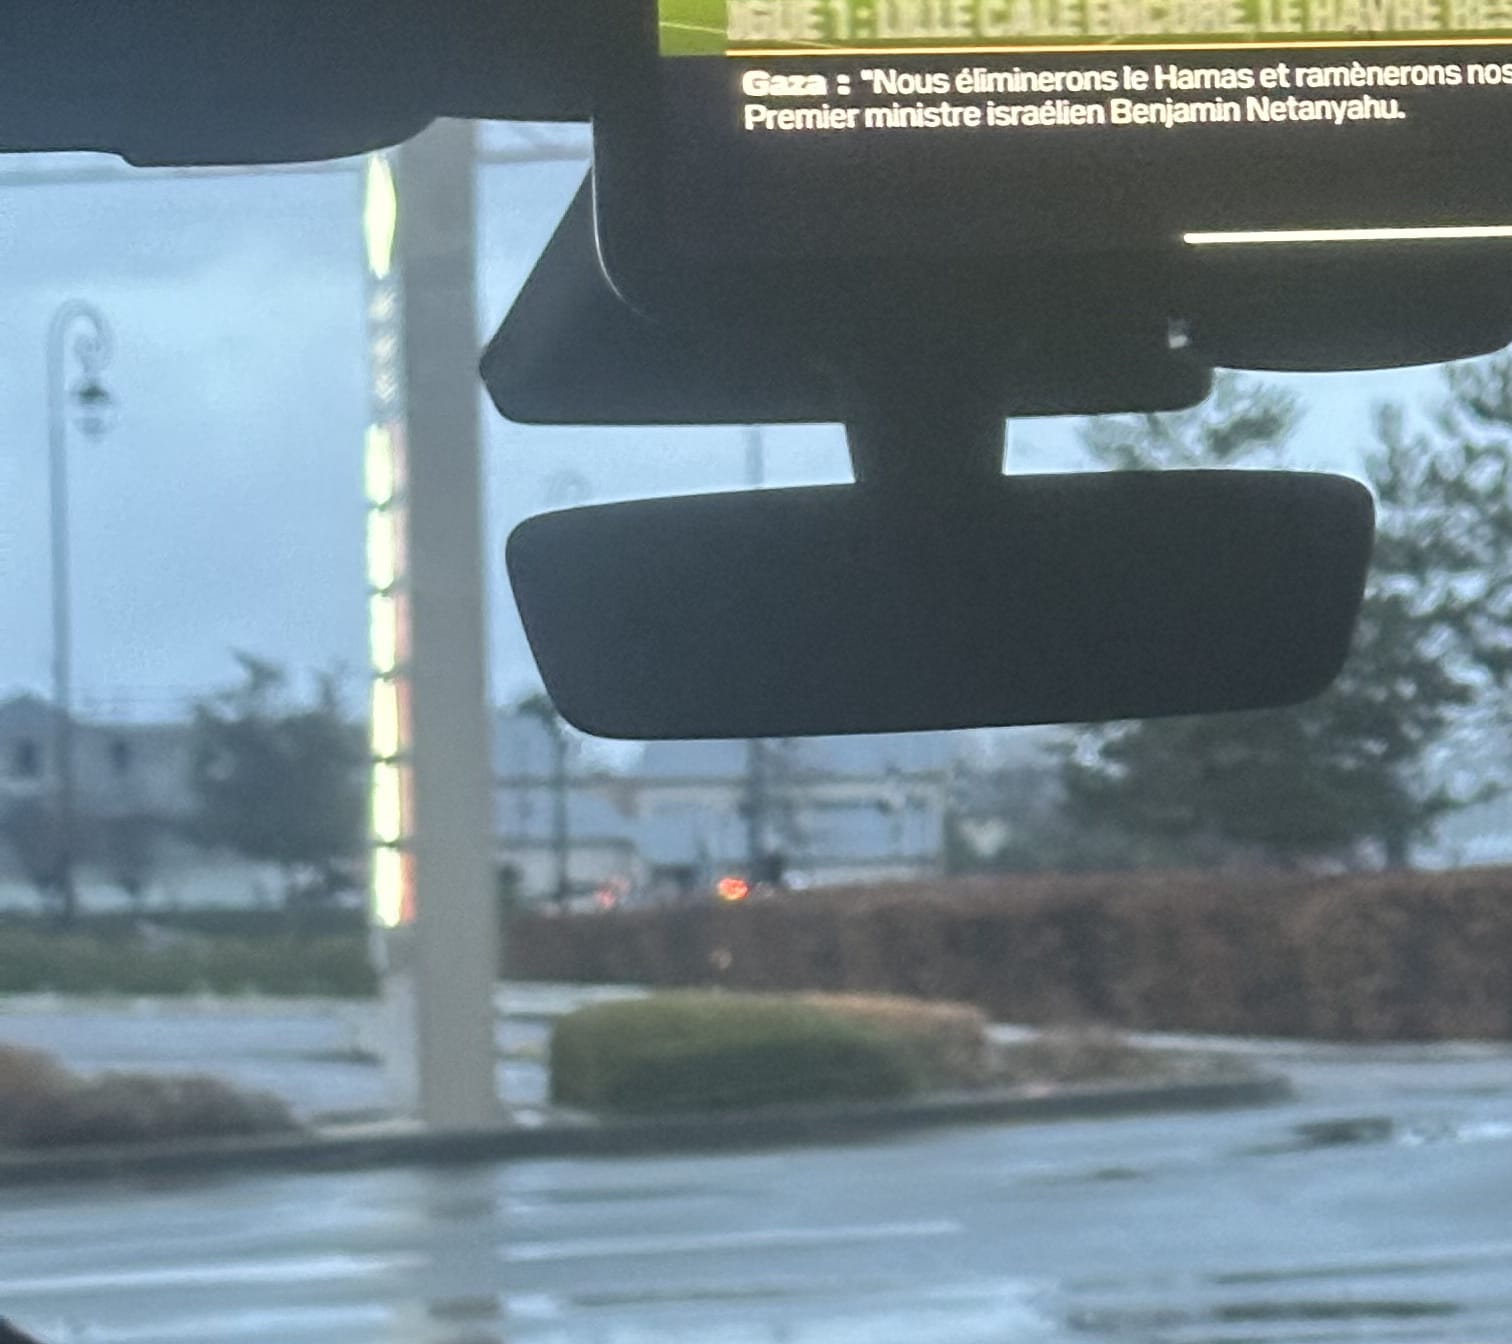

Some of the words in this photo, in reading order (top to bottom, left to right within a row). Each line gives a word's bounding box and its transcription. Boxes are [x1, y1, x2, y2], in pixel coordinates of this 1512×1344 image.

[742, 70, 826, 96] Gaza
[860, 68, 949, 95] "Nous
[956, 67, 1118, 94] éliminerons
[1124, 65, 1149, 91] le
[1154, 65, 1255, 90] Hamas
[1259, 63, 1290, 89] et
[1295, 61, 1463, 87] ramènerons
[744, 103, 859, 130] Premier
[865, 101, 981, 128] ministre
[986, 100, 1104, 128] israélien
[1111, 97, 1240, 128] Benjamin
[1246, 94, 1406, 126] Netanyahu.
